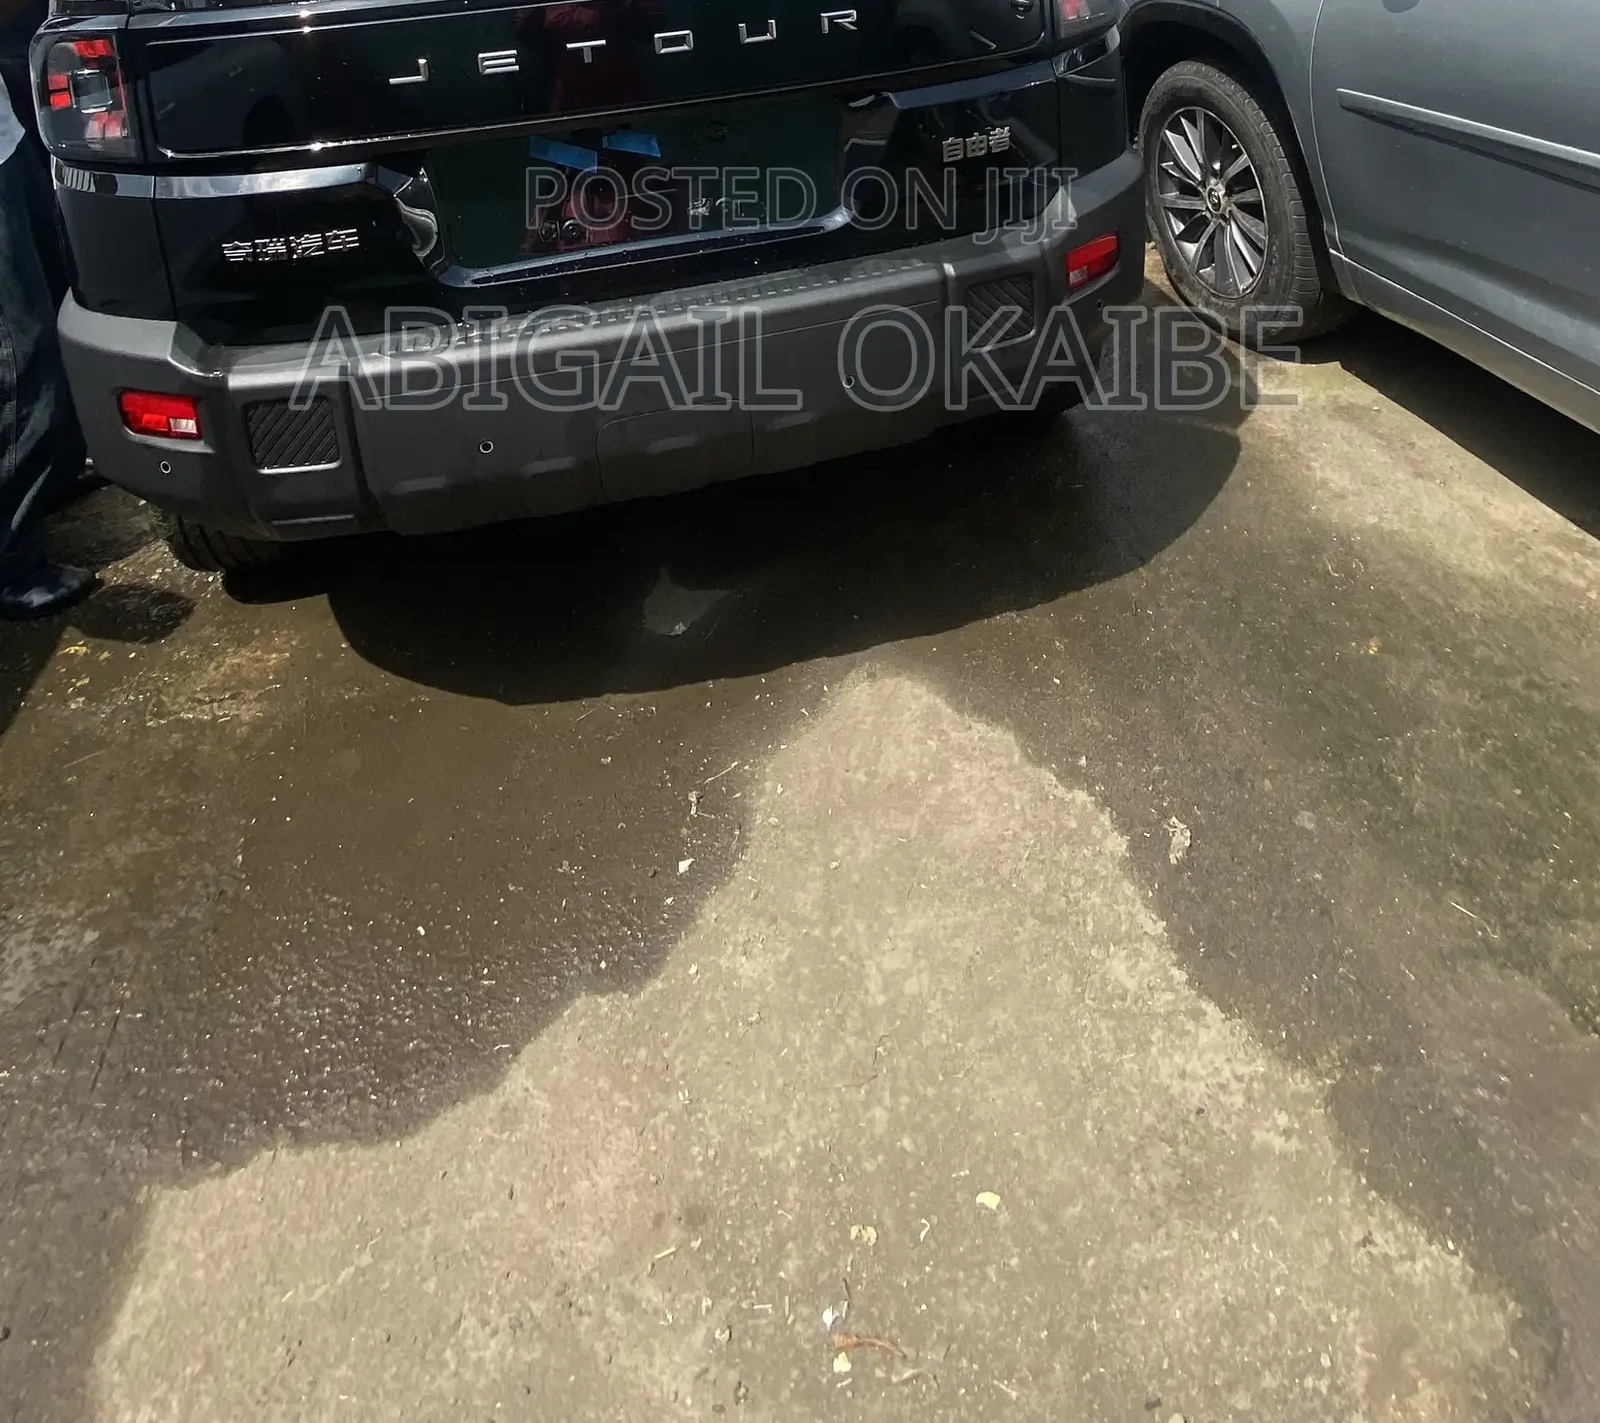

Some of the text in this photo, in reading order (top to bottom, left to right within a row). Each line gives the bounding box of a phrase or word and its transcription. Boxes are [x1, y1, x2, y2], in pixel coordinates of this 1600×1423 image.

[389, 9, 858, 85] JETOUR
[942, 127, 1011, 163] 自由者
[221, 228, 360, 264] 奇瑞汽车
